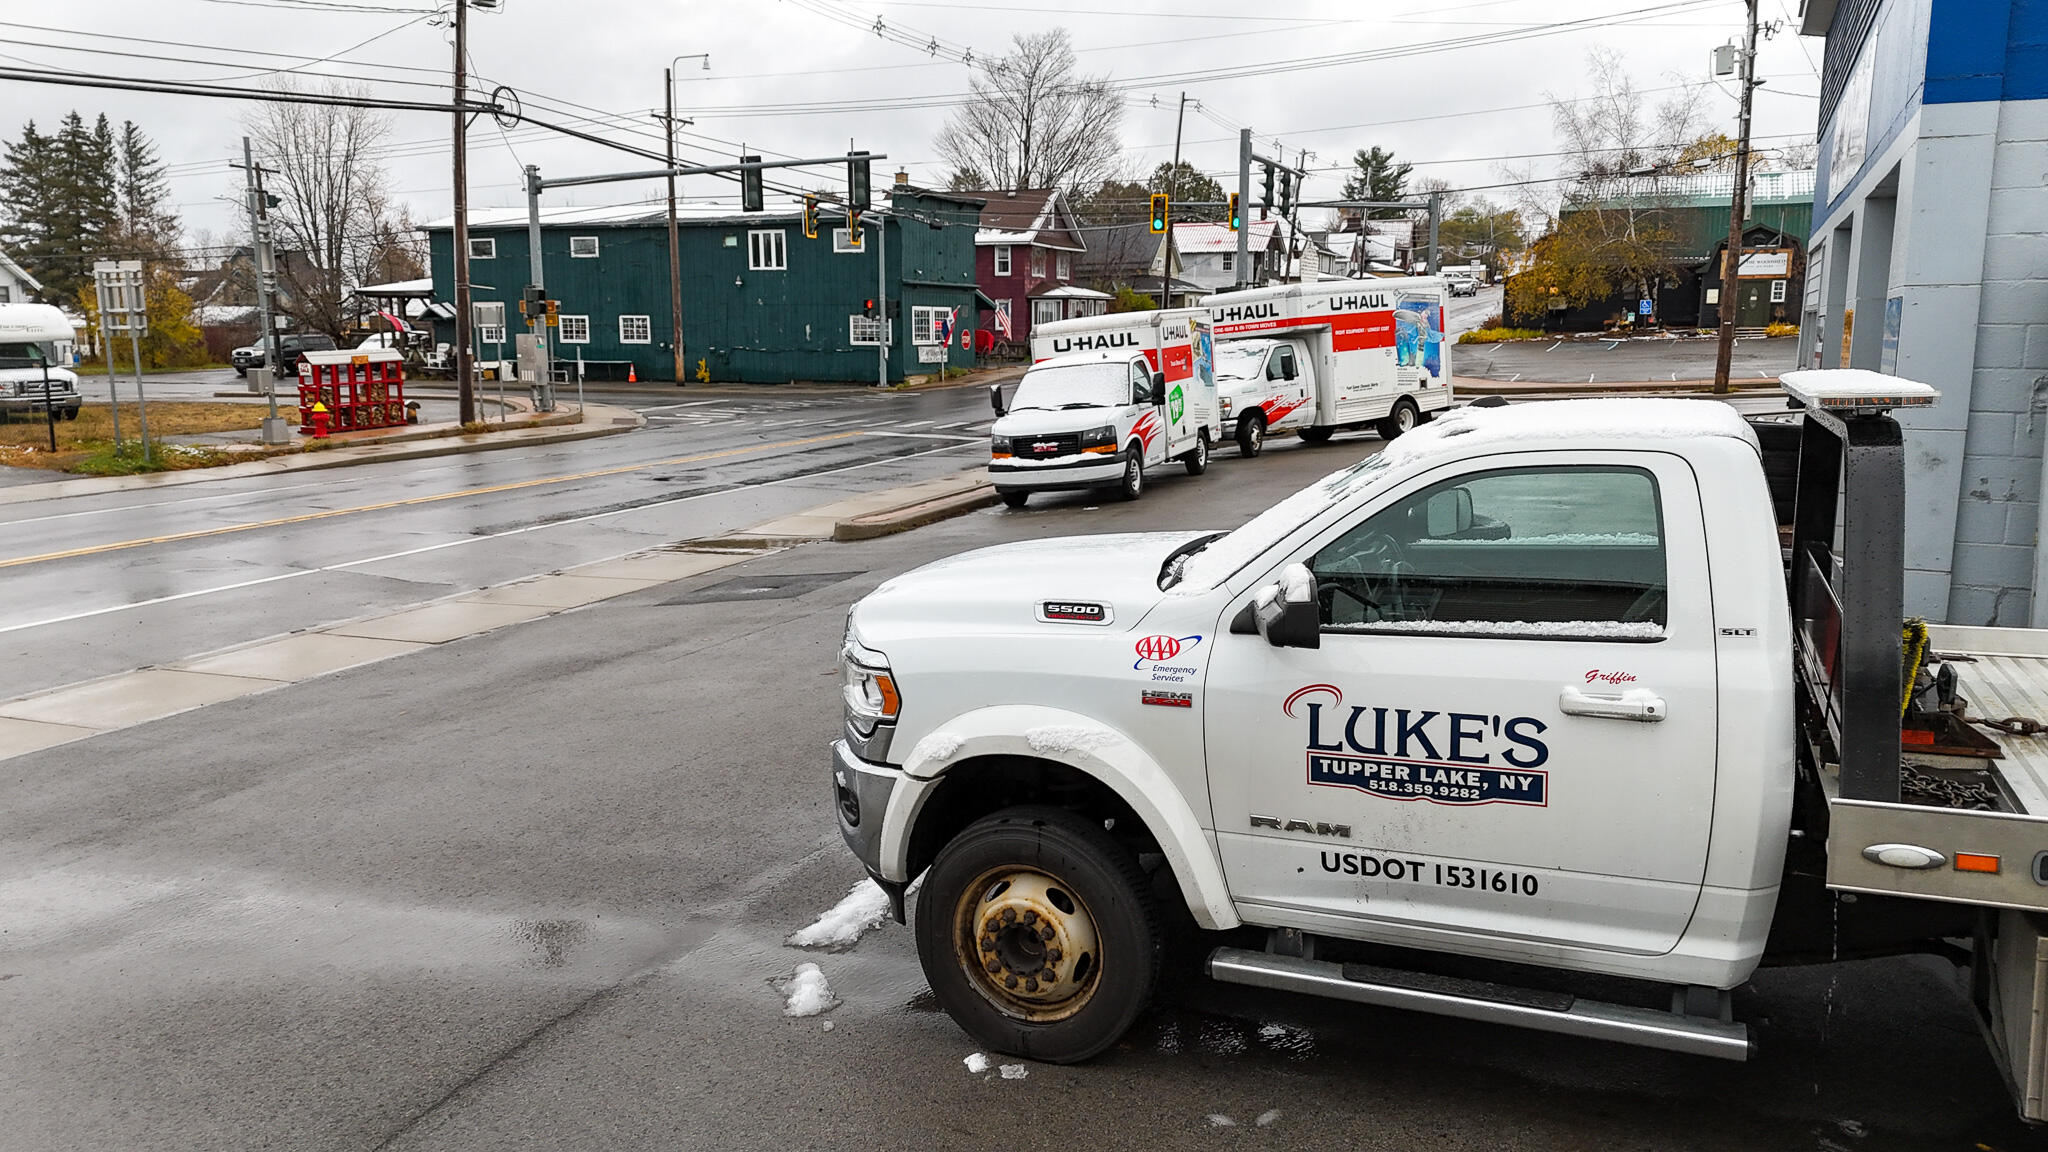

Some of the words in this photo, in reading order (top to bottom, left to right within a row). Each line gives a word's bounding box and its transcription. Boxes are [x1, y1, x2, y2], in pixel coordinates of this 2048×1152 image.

[1330, 294, 1389, 311] U-HAUL
[1212, 303, 1279, 323] U-HAUL
[1162, 325, 1189, 341] U-HAUL
[1260, 321, 1277, 329] MOVES
[1053, 332, 1139, 352] U-HAUL
[1047, 604, 1100, 614] 5500
[1721, 628, 1755, 636] SLT
[1138, 635, 1178, 661] AAA
[1151, 673, 1184, 682] Services
[1152, 664, 1198, 675] Emergency
[1585, 669, 1638, 685] Griffin
[1141, 689, 1192, 699] HEMI
[1306, 702, 1549, 768] LUKE'S
[1319, 758, 1411, 781] TUPPER
[1420, 767, 1489, 791] LAKE,
[1500, 775, 1534, 791] NY
[1369, 779, 1480, 799] 518.359.9282
[1250, 814, 1351, 838] RAM
[1320, 851, 1425, 882] USDOT
[1435, 863, 1539, 896] 1531610
